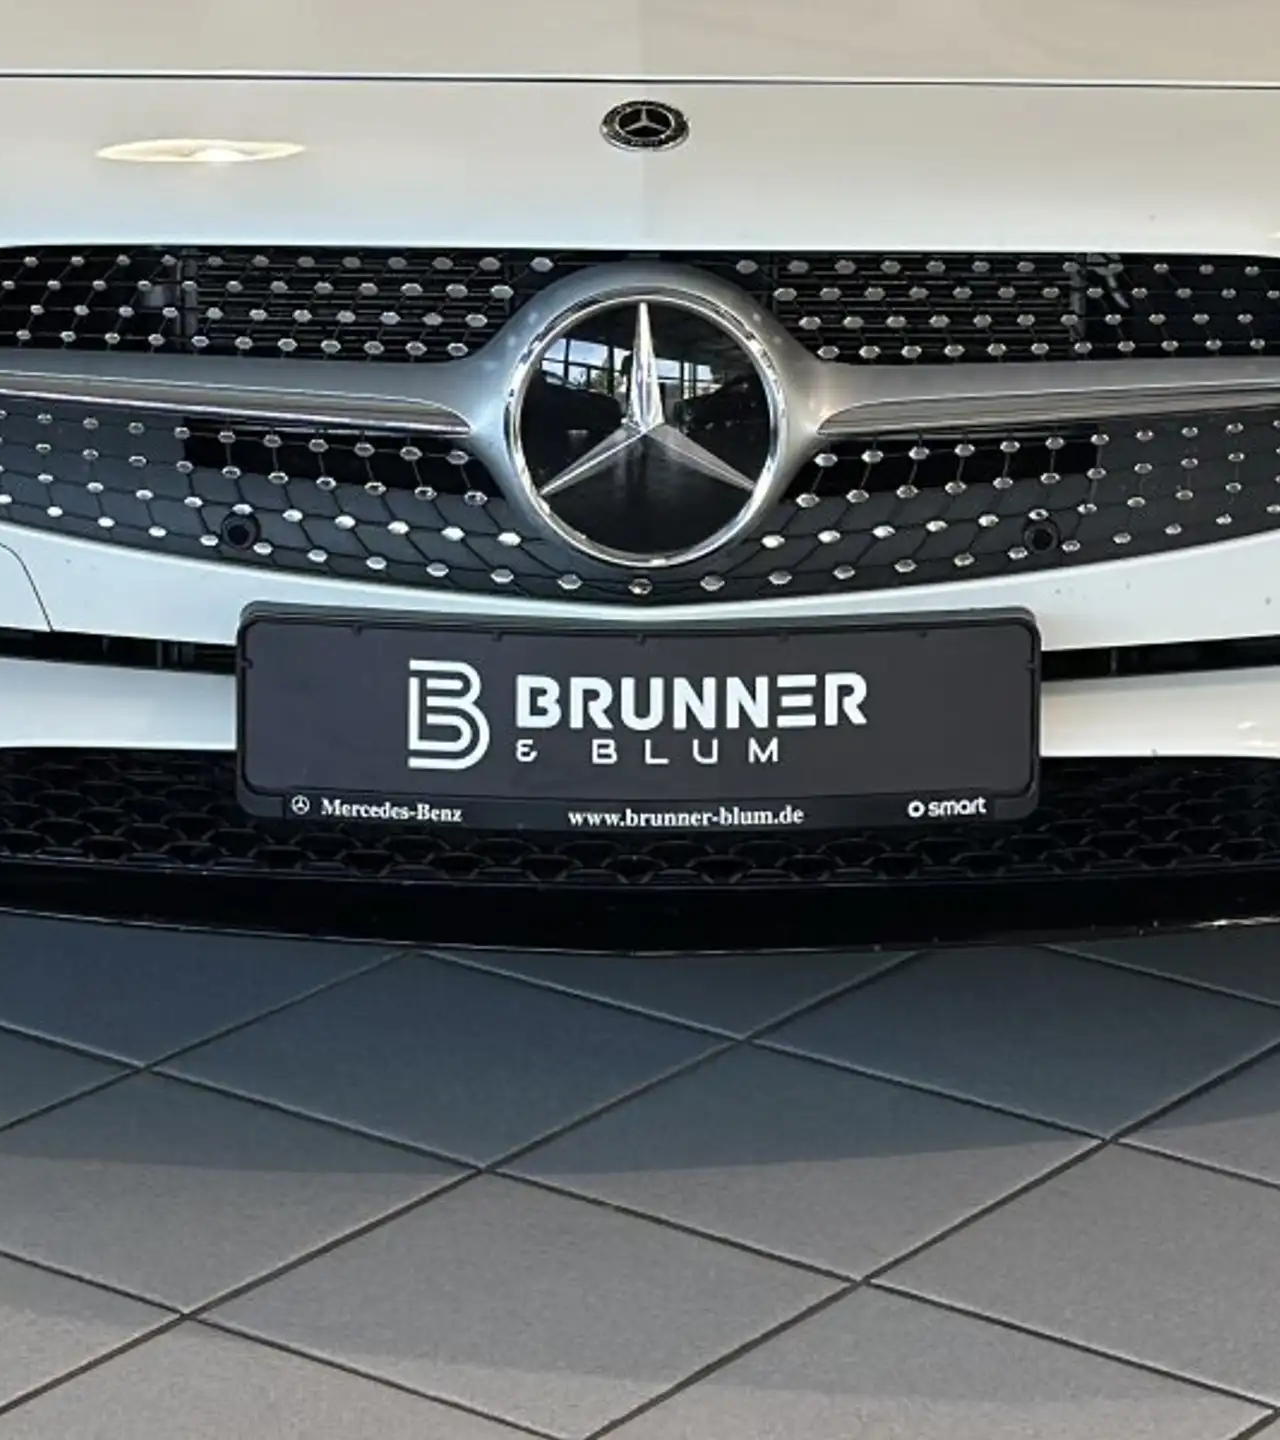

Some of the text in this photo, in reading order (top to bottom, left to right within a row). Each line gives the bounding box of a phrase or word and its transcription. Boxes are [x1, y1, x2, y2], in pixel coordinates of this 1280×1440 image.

[515, 672, 869, 732] BRUNNER
[515, 736, 780, 765] & BLUM
[321, 797, 463, 823] Mercedes-Benz
[566, 804, 805, 828] www.brunner-blum.de
[926, 796, 988, 818] smart
